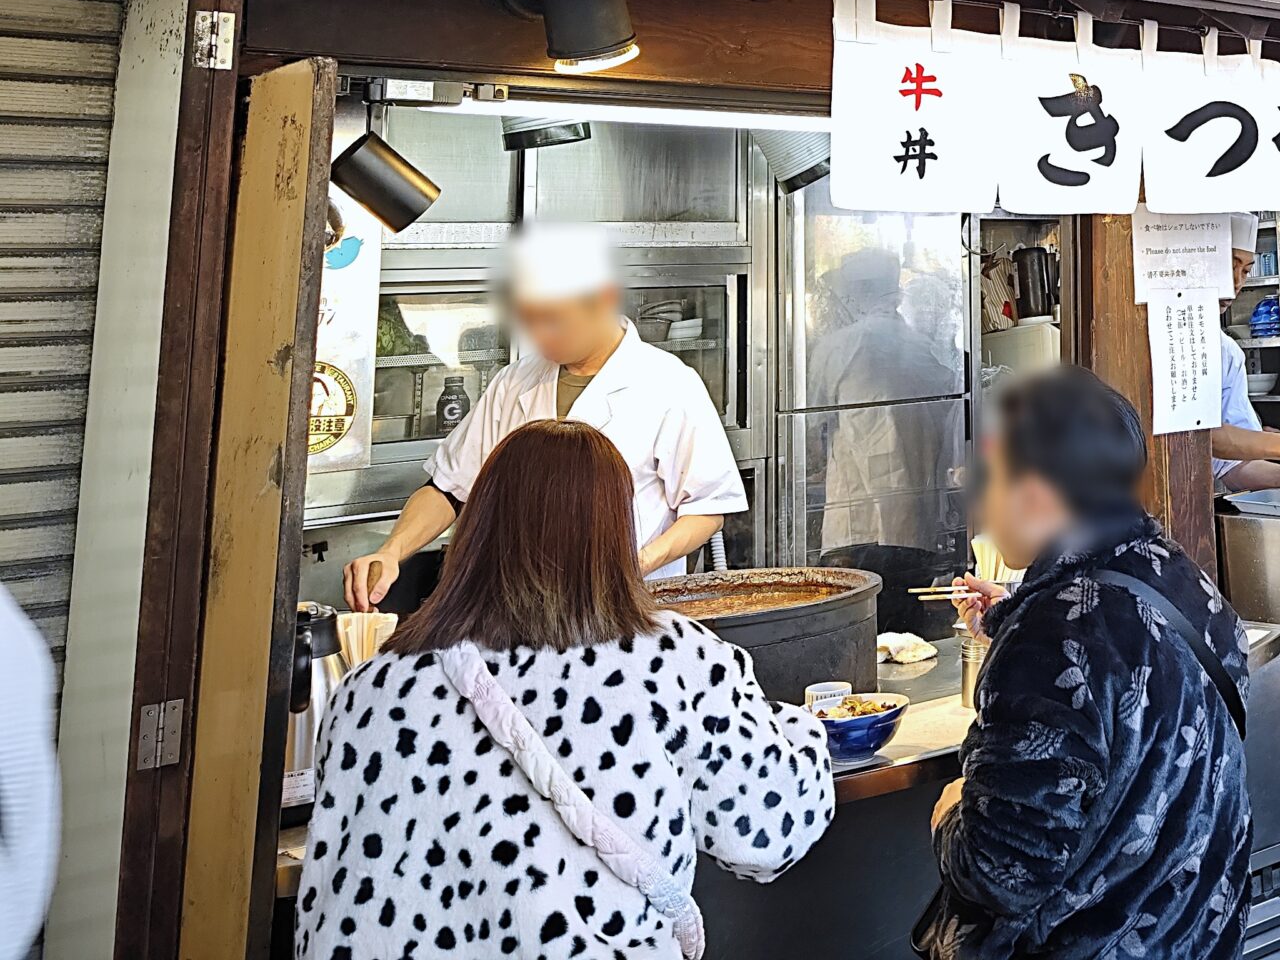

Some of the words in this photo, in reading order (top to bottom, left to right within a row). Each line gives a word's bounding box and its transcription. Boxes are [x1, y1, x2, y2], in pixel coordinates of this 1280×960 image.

[893, 63, 942, 180] 牛丼
[1145, 247, 1163, 255] Please
[1164, 247, 1171, 255] do
[1182, 246, 1196, 254] share
[1206, 245, 1217, 253] food
